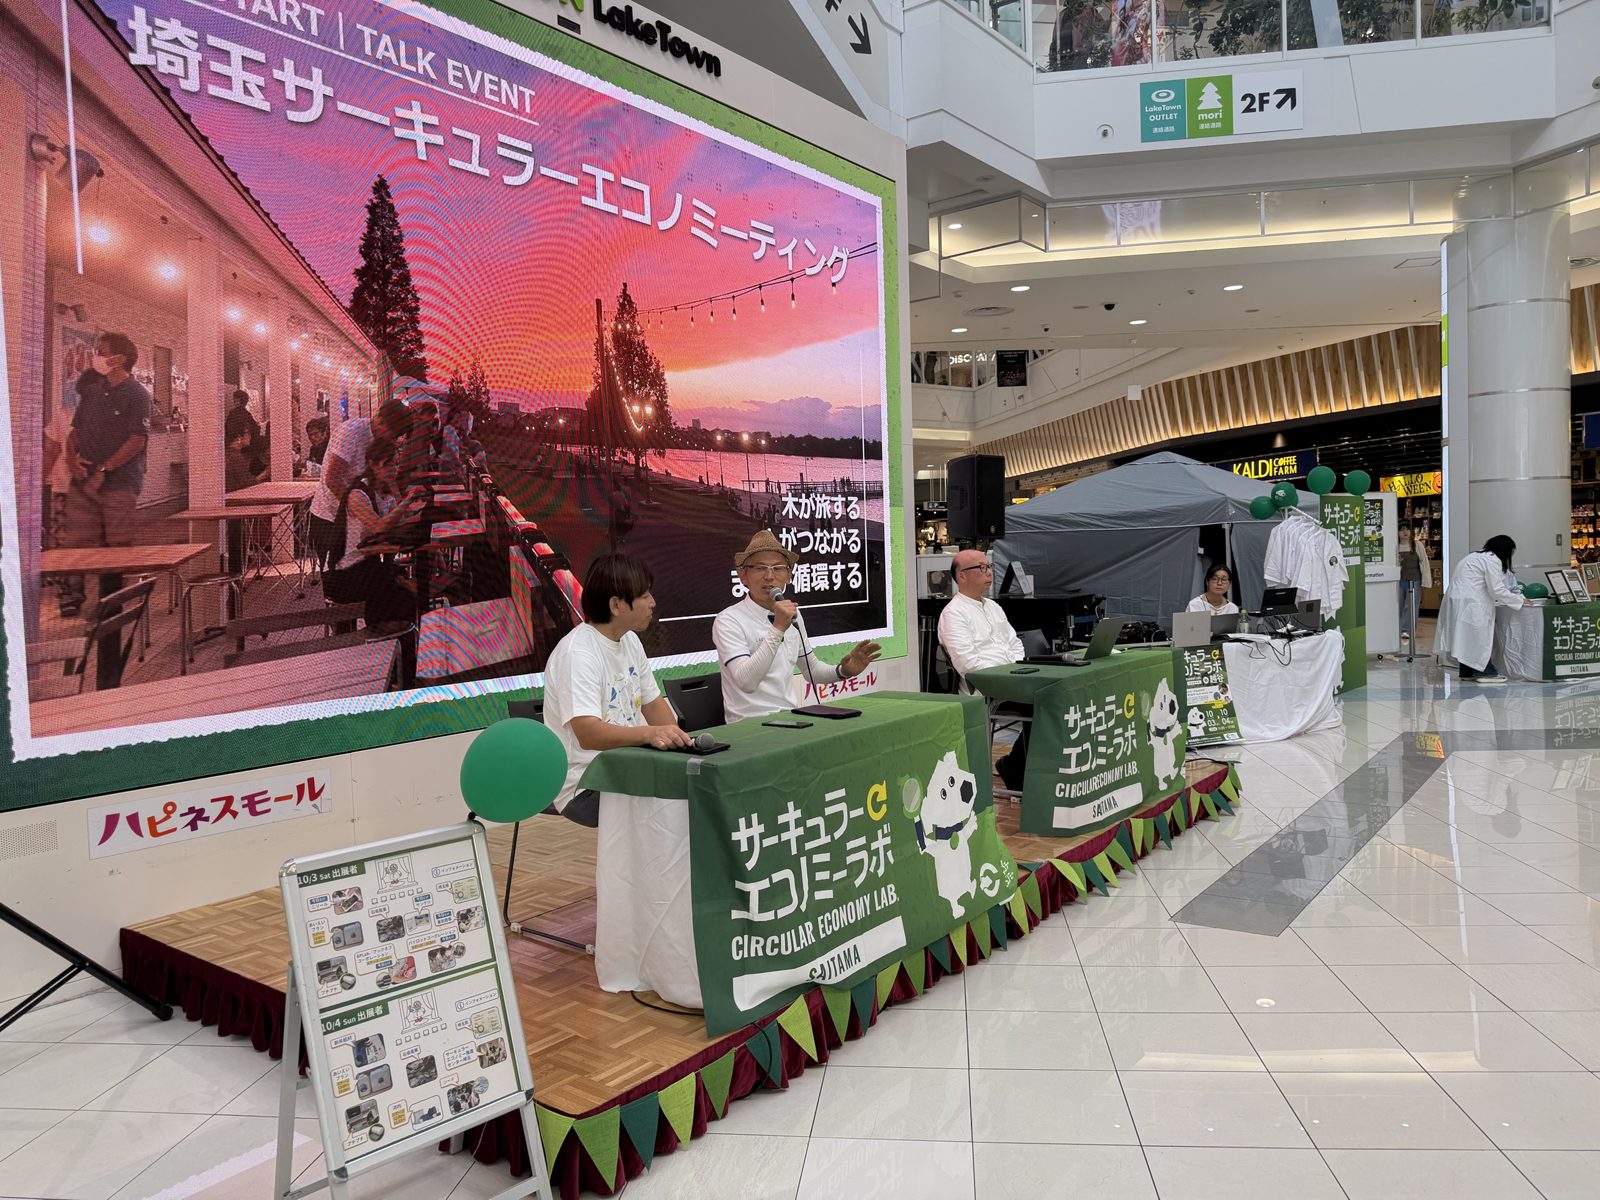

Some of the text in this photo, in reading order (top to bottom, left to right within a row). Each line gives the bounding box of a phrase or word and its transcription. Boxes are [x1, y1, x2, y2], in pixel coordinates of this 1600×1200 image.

[593, 0, 721, 77] LakeTown
[356, 23, 438, 80] TALK
[447, 57, 536, 114] EVENT
[1145, 104, 1181, 113] LakeTown
[1198, 109, 1223, 120] mori
[1240, 92, 1270, 113] 2F
[1149, 112, 1178, 121] OUTLET
[127, 6, 850, 284] 埼玉サーキュラーエコノミーティング
[1233, 455, 1297, 478] KALDI COFFEE
[1273, 465, 1297, 476] FARM
[781, 493, 861, 519] 木が旅する
[1324, 503, 1353, 524] サーキュラー
[768, 528, 862, 554] がつながる
[1552, 616, 1596, 633] サーキュラー
[1064, 695, 1123, 740] サーキュラー
[97, 776, 326, 846] ハピネスモール
[731, 788, 864, 871] サーキュラー
[298, 864, 358, 885] 10/3 Sat 出展者
[731, 823, 895, 921] エコノミーラボ
[731, 883, 900, 961] CIRCULAR ECONOMY LAB.
[806, 943, 862, 983] SAITAMA
[321, 1005, 384, 1032] 10/4 Sun 出展者
